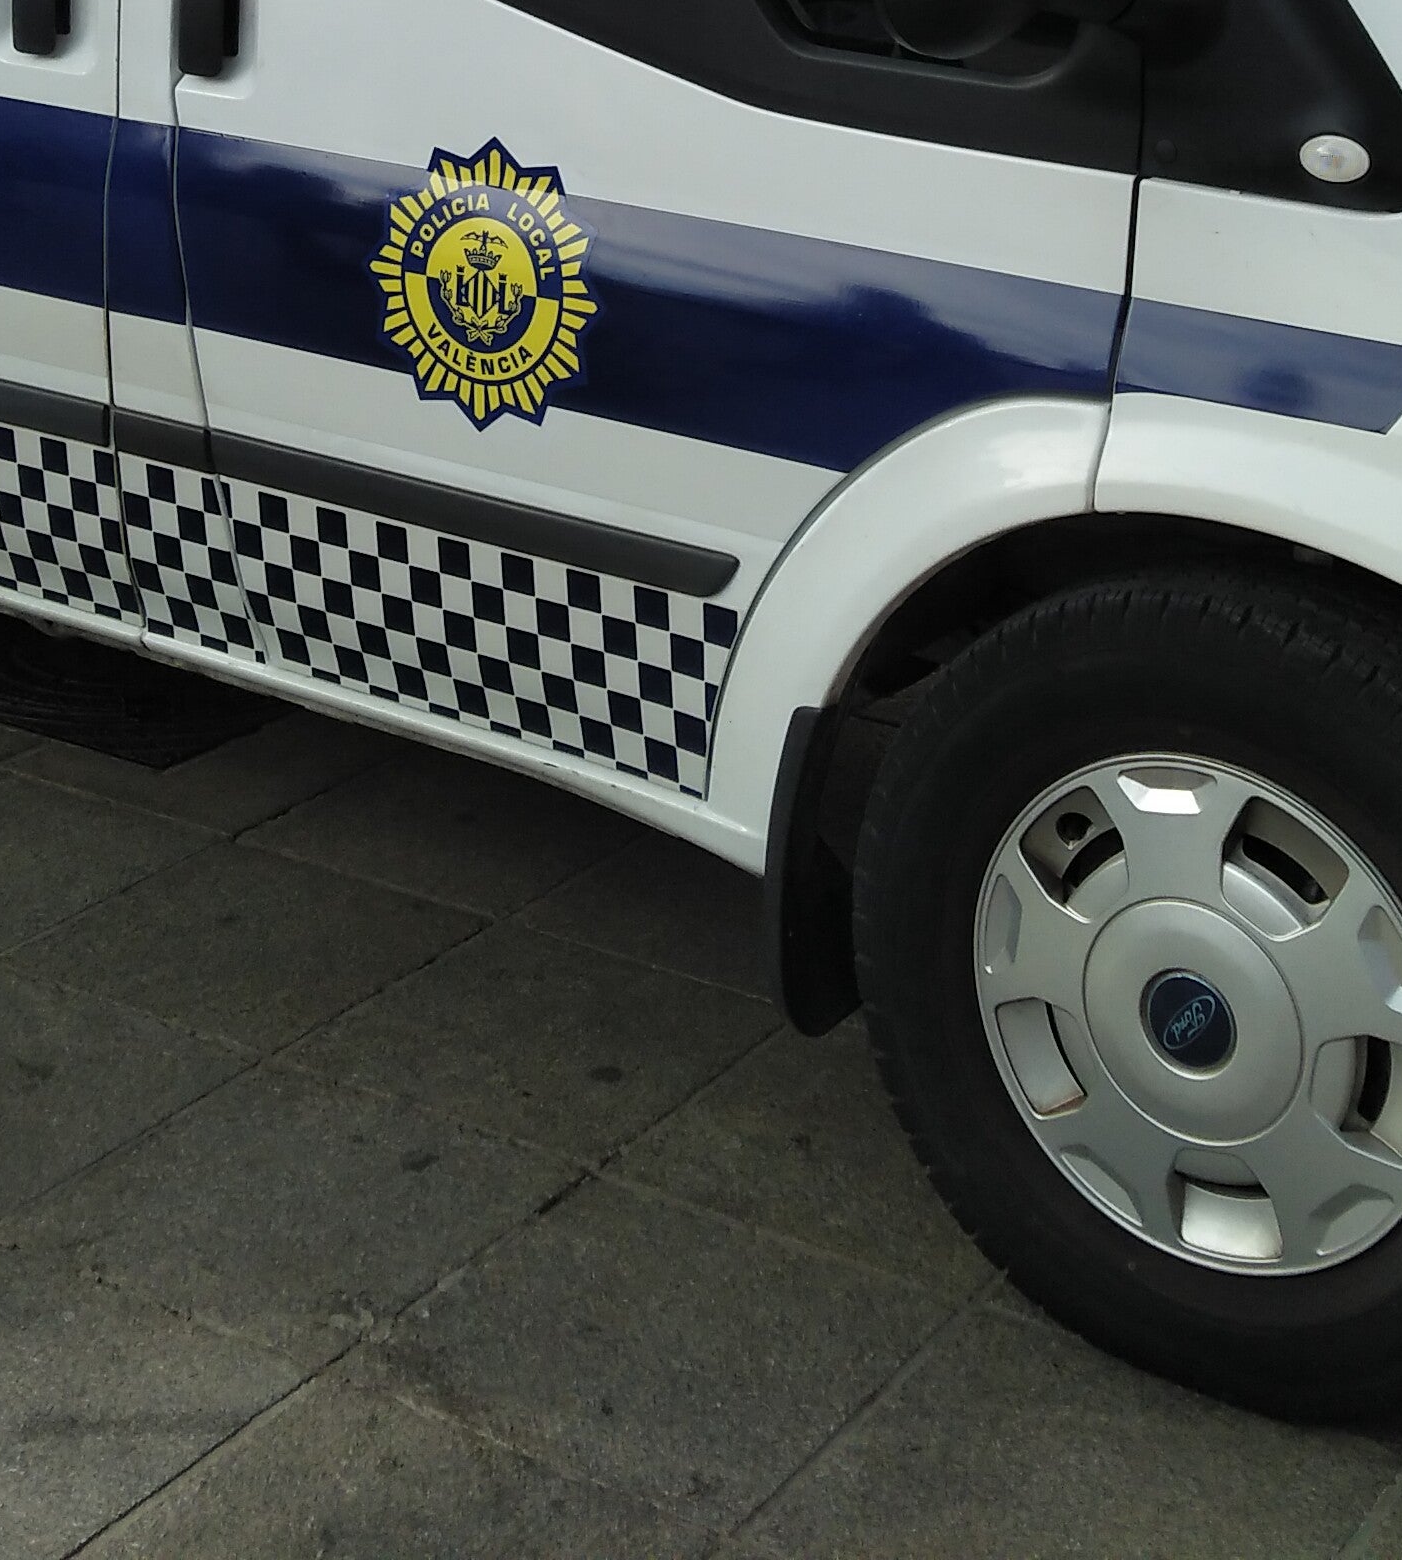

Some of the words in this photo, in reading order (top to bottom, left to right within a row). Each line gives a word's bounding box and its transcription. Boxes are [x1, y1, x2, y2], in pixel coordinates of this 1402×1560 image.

[410, 193, 491, 259] POLICIA
[505, 202, 557, 282] LOCAL
[427, 323, 534, 376] VALÈNCIA
[1170, 1000, 1207, 1044] Ford
